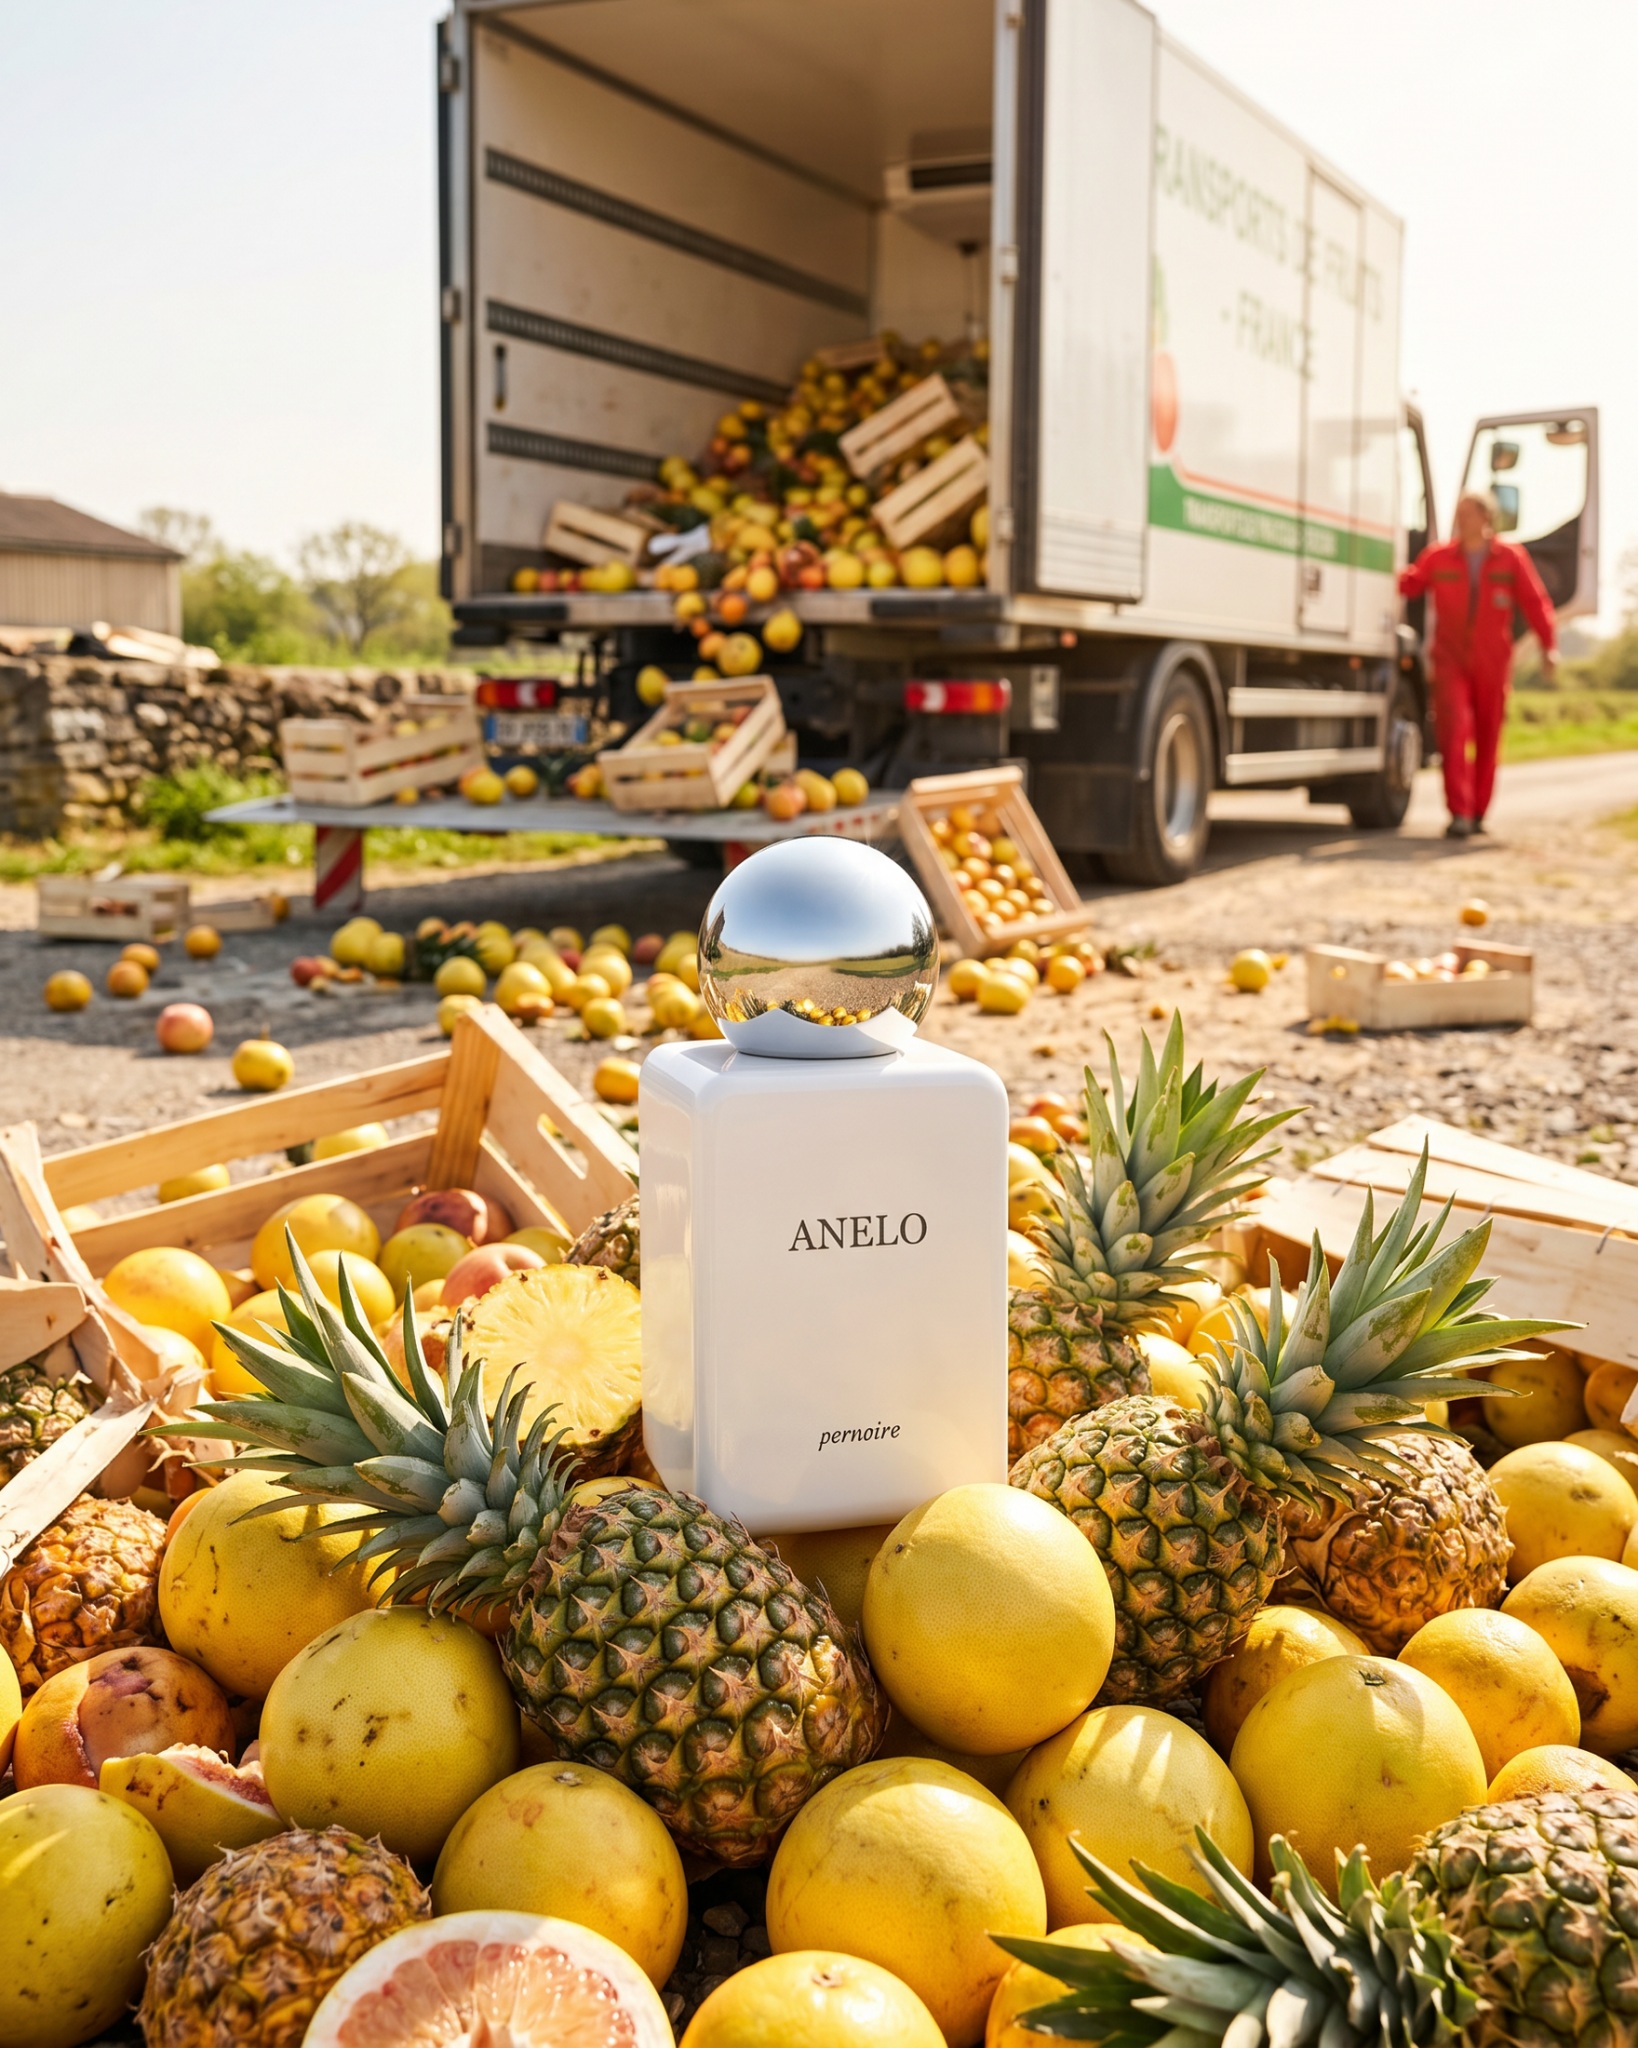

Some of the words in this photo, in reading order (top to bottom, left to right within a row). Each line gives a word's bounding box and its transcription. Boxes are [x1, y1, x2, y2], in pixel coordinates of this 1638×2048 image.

[1155, 122, 1287, 266] RANSPORTS
[1323, 239, 1383, 325] FRUTS
[788, 1212, 928, 1252] ANELO
[818, 1421, 901, 1452] pernoire
